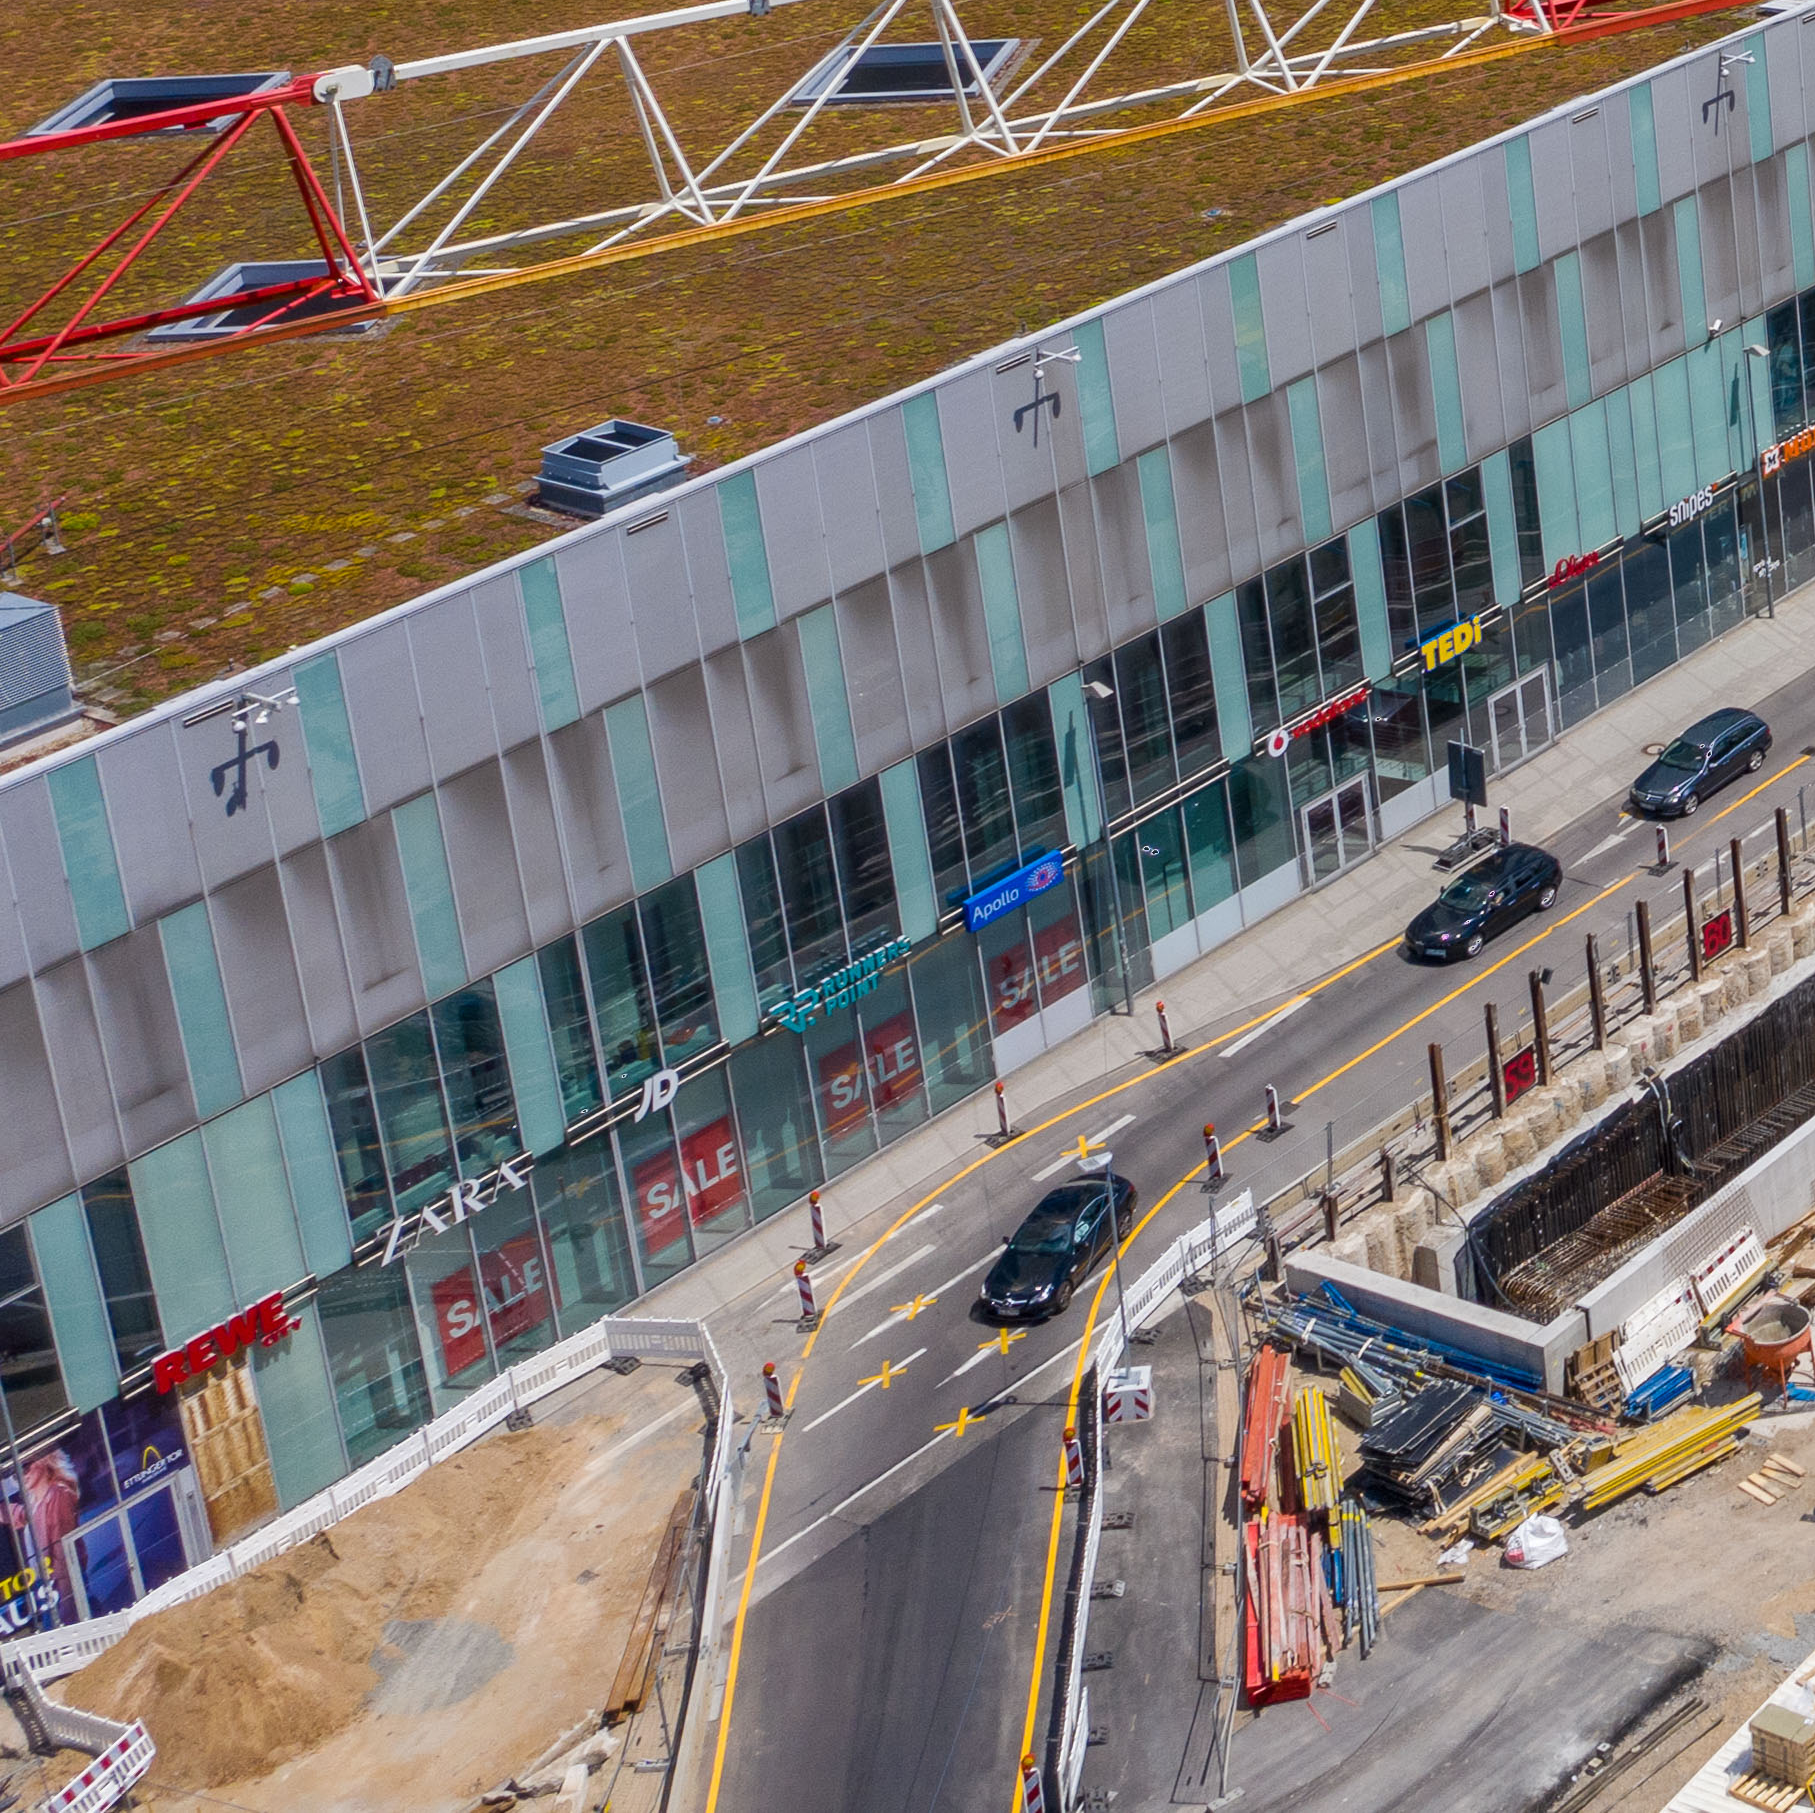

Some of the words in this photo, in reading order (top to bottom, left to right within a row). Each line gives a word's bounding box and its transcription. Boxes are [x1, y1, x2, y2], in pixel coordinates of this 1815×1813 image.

[1669, 484, 1715, 527] snipes
[1421, 615, 1482, 673] TEDi
[973, 888, 1020, 923] Apollo
[1703, 913, 1733, 959] 60
[821, 935, 911, 997] RUNNERS
[824, 971, 879, 1016] POINT
[634, 1069, 679, 1124] JD
[831, 1036, 916, 1109] SALE
[1504, 1051, 1536, 1105] 59
[647, 1141, 737, 1219] SALE
[376, 1162, 528, 1268] ZARA
[447, 1257, 542, 1338] SALE
[151, 1290, 289, 1395] REWE
